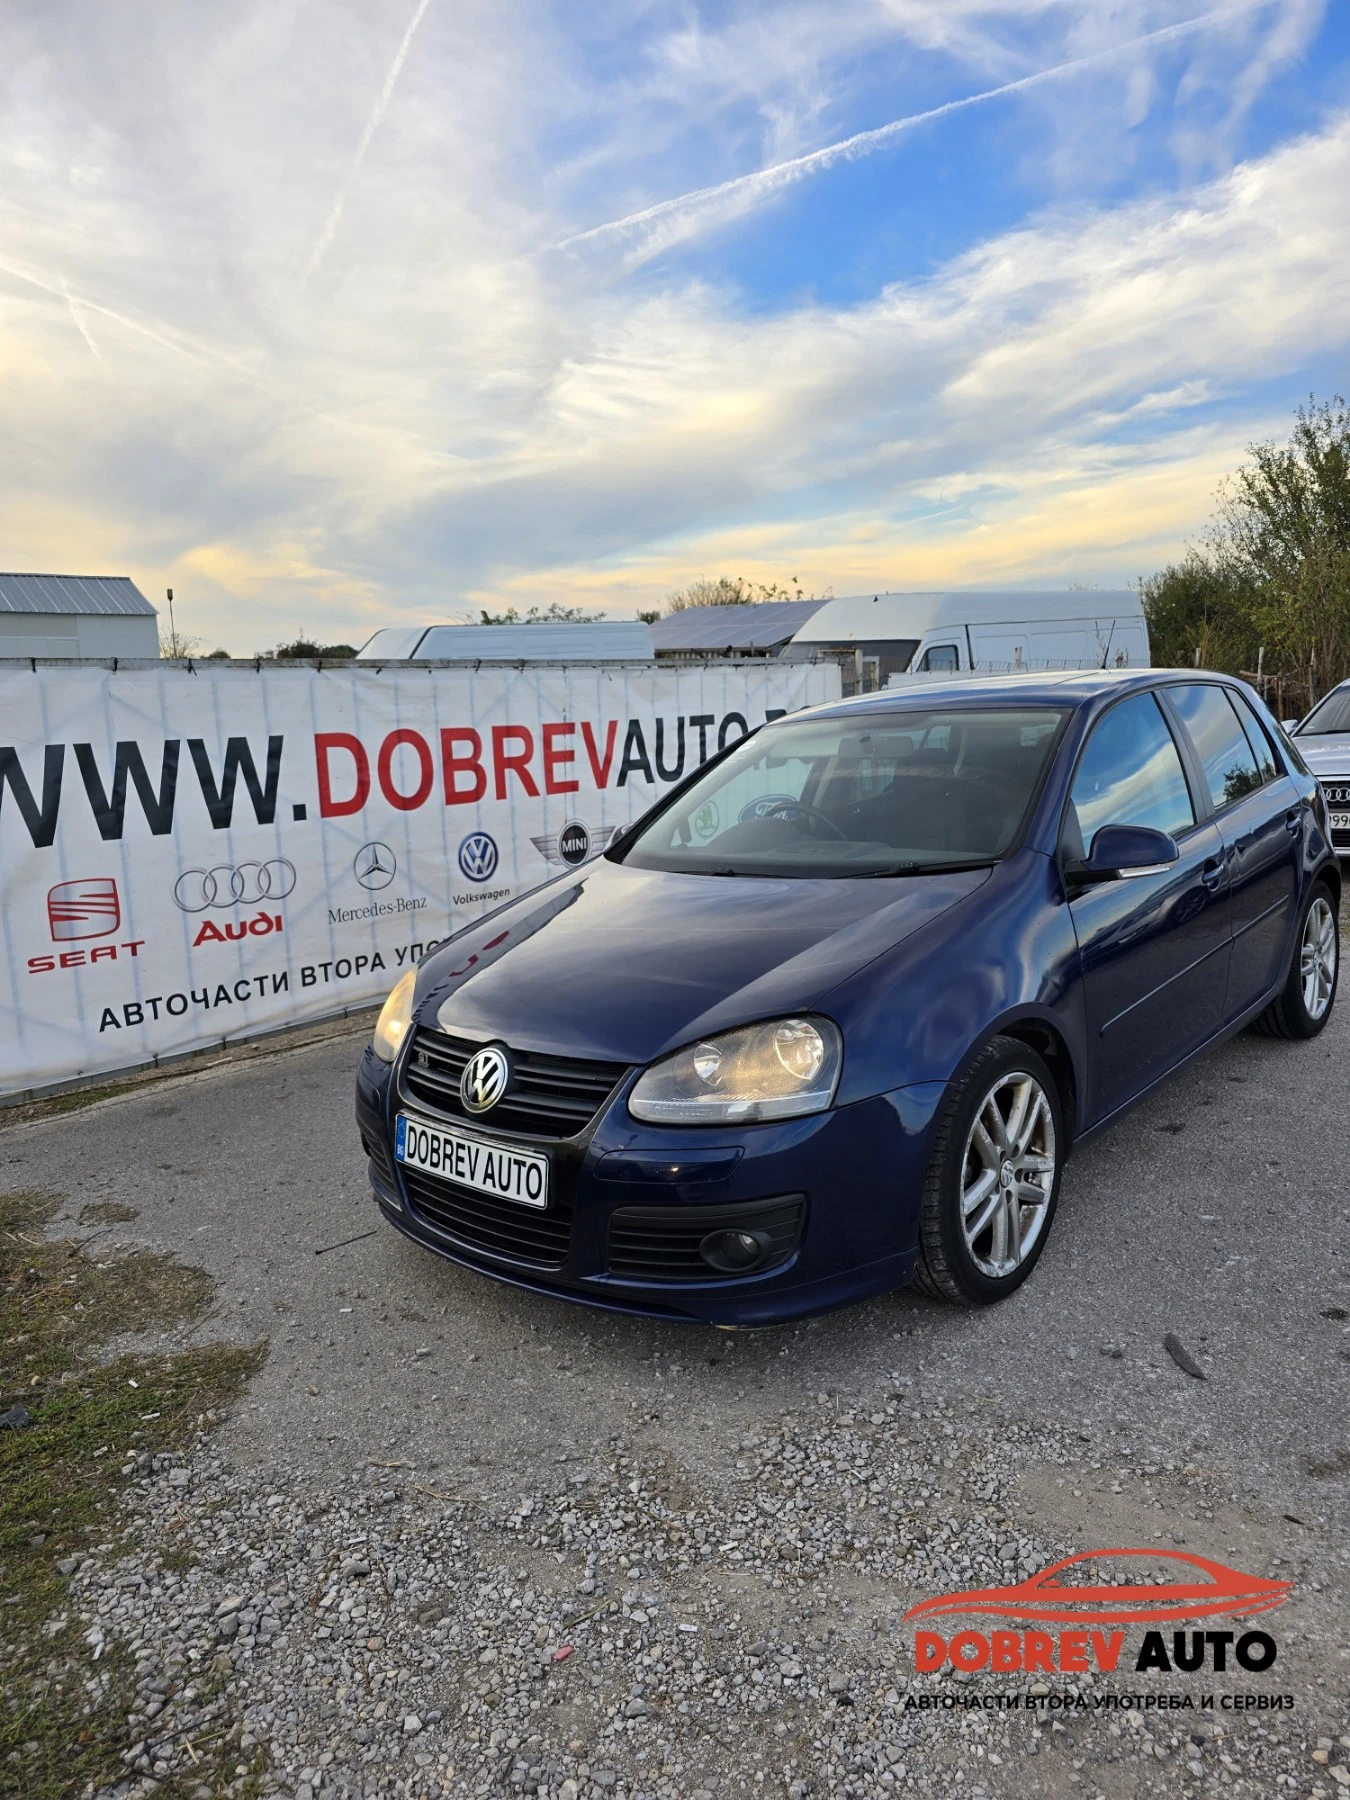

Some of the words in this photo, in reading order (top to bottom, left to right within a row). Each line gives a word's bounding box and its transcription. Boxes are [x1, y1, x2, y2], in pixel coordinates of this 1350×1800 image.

[1329, 814, 1350, 827] 99
[562, 837, 587, 852] MINI
[327, 897, 427, 924] Mercedes-Benz
[452, 888, 510, 905] Volkswagen
[192, 911, 283, 947] Audi
[27, 940, 145, 974] SEAT
[99, 971, 289, 1032] АВТОЧАСТИ
[301, 952, 386, 987] ВТОРА
[407, 1125, 480, 1182] DOBREV
[482, 1151, 543, 1200] AUTO
